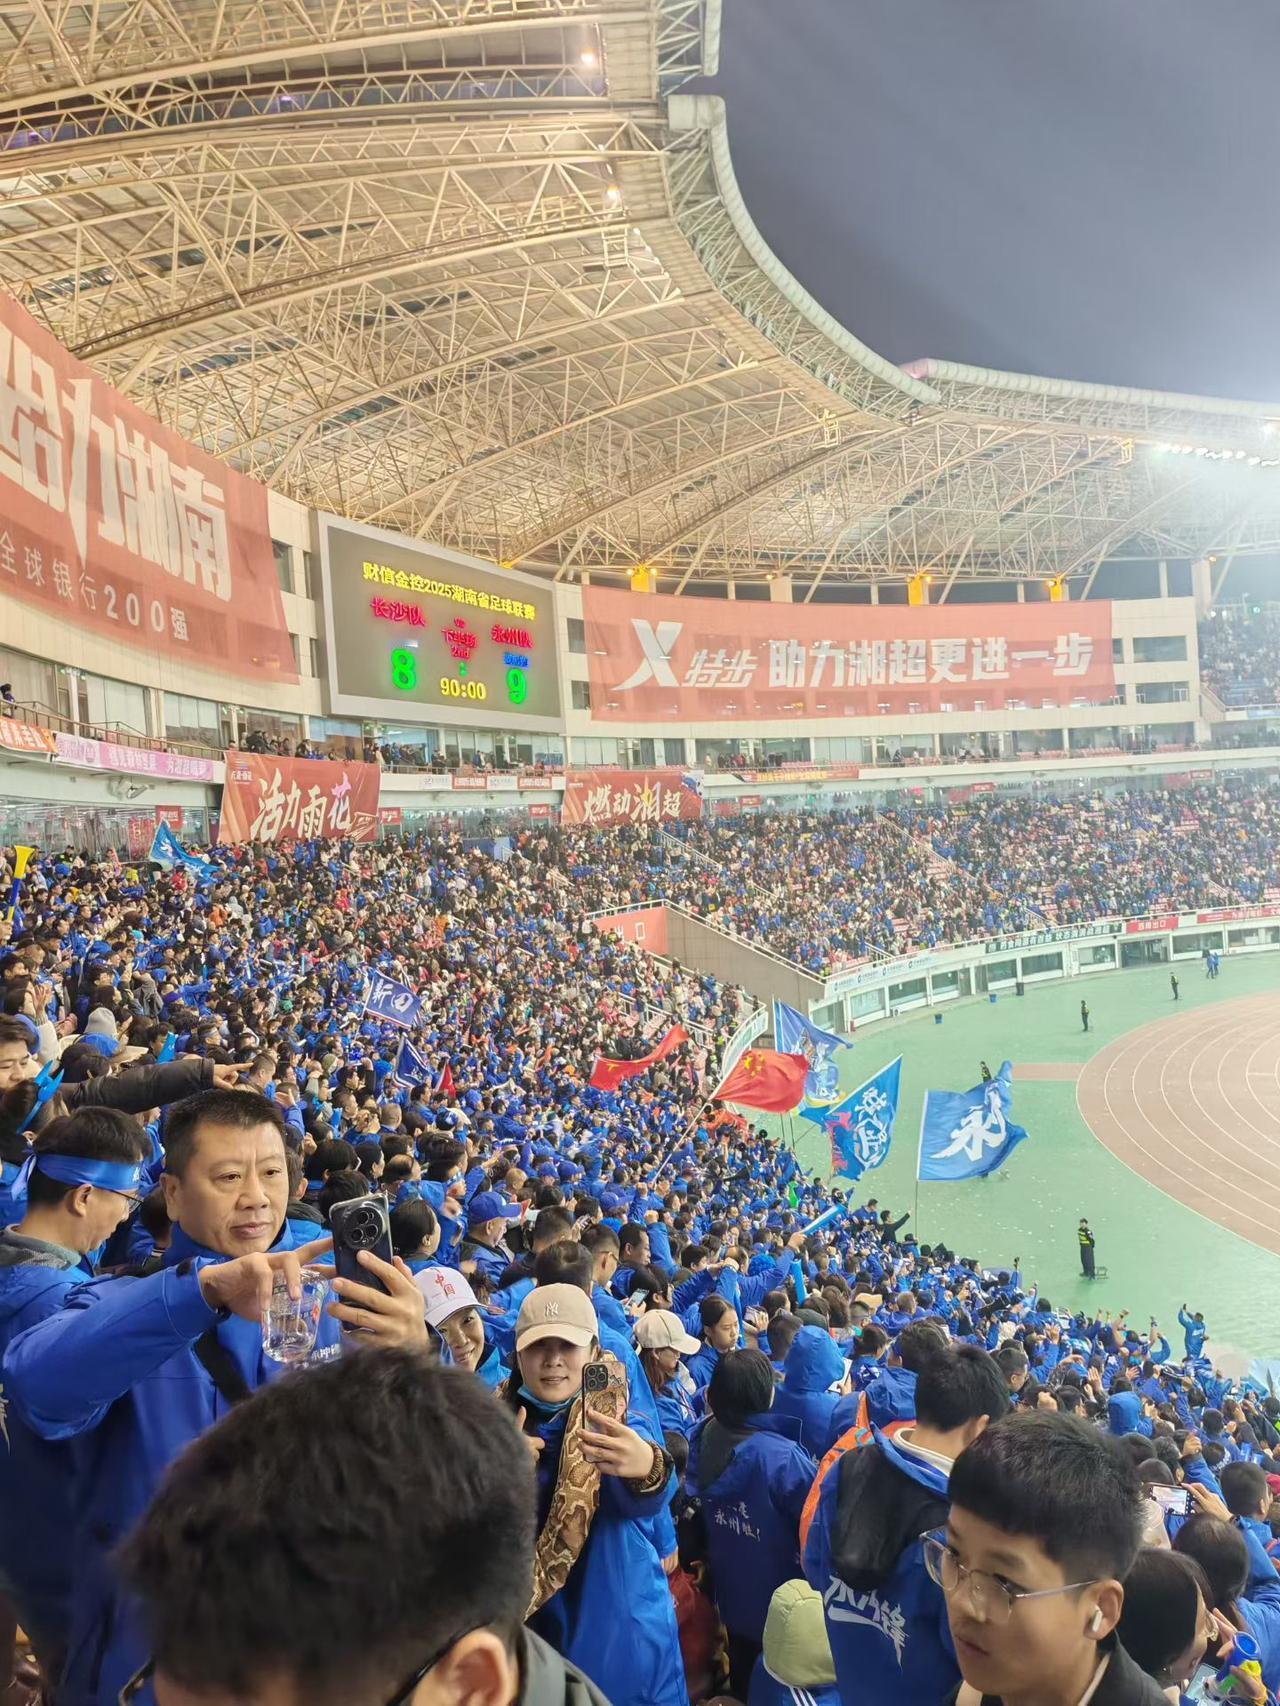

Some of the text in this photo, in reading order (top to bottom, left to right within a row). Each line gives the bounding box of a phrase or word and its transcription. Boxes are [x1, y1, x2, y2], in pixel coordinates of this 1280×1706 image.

[0, 530, 190, 642] 全球银行200强
[363, 562, 536, 621] 财信金控2025湖南省足球联赛
[371, 597, 425, 627] 长沙队
[451, 645, 470, 660] 2nd
[490, 624, 533, 649] 永州队
[391, 648, 416, 690] 8
[681, 648, 757, 688] 特步
[769, 632, 1094, 688] 助力湘超更进一步
[440, 677, 487, 700] 90:00
[506, 668, 527, 705] 9
[250, 767, 354, 842] 活力雨花
[583, 775, 684, 823] 燃动湘超
[435, 1273, 456, 1298] 中国
